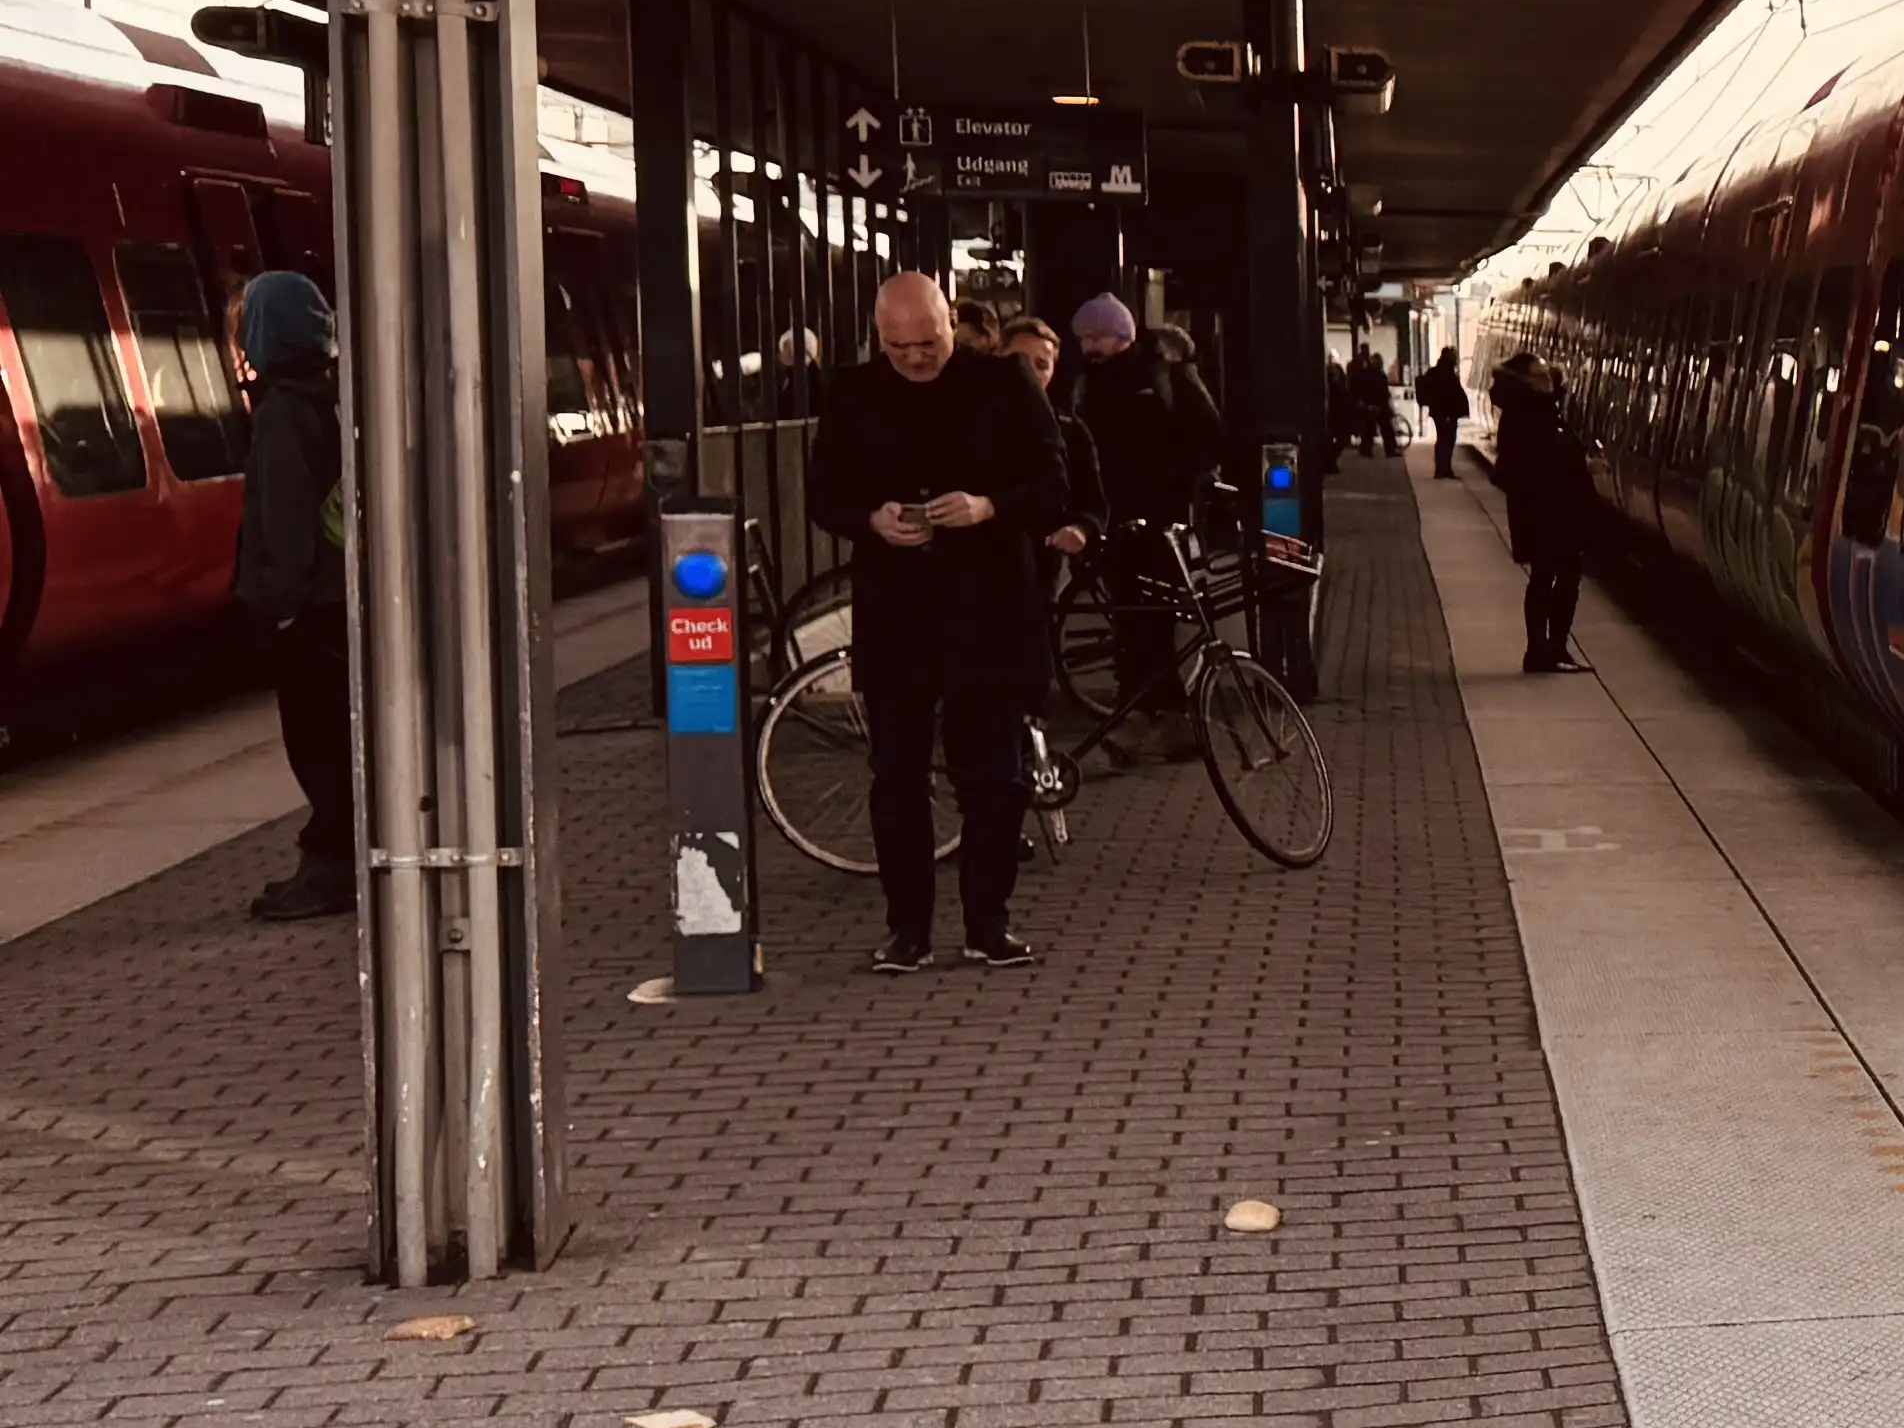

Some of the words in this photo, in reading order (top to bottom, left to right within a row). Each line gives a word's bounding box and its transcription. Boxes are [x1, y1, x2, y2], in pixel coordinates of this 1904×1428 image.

[955, 118, 1032, 136] Elevator
[957, 155, 1029, 176] Udgang
[957, 175, 982, 188] Exit
[671, 617, 729, 634] Check
[688, 635, 713, 651] ud
